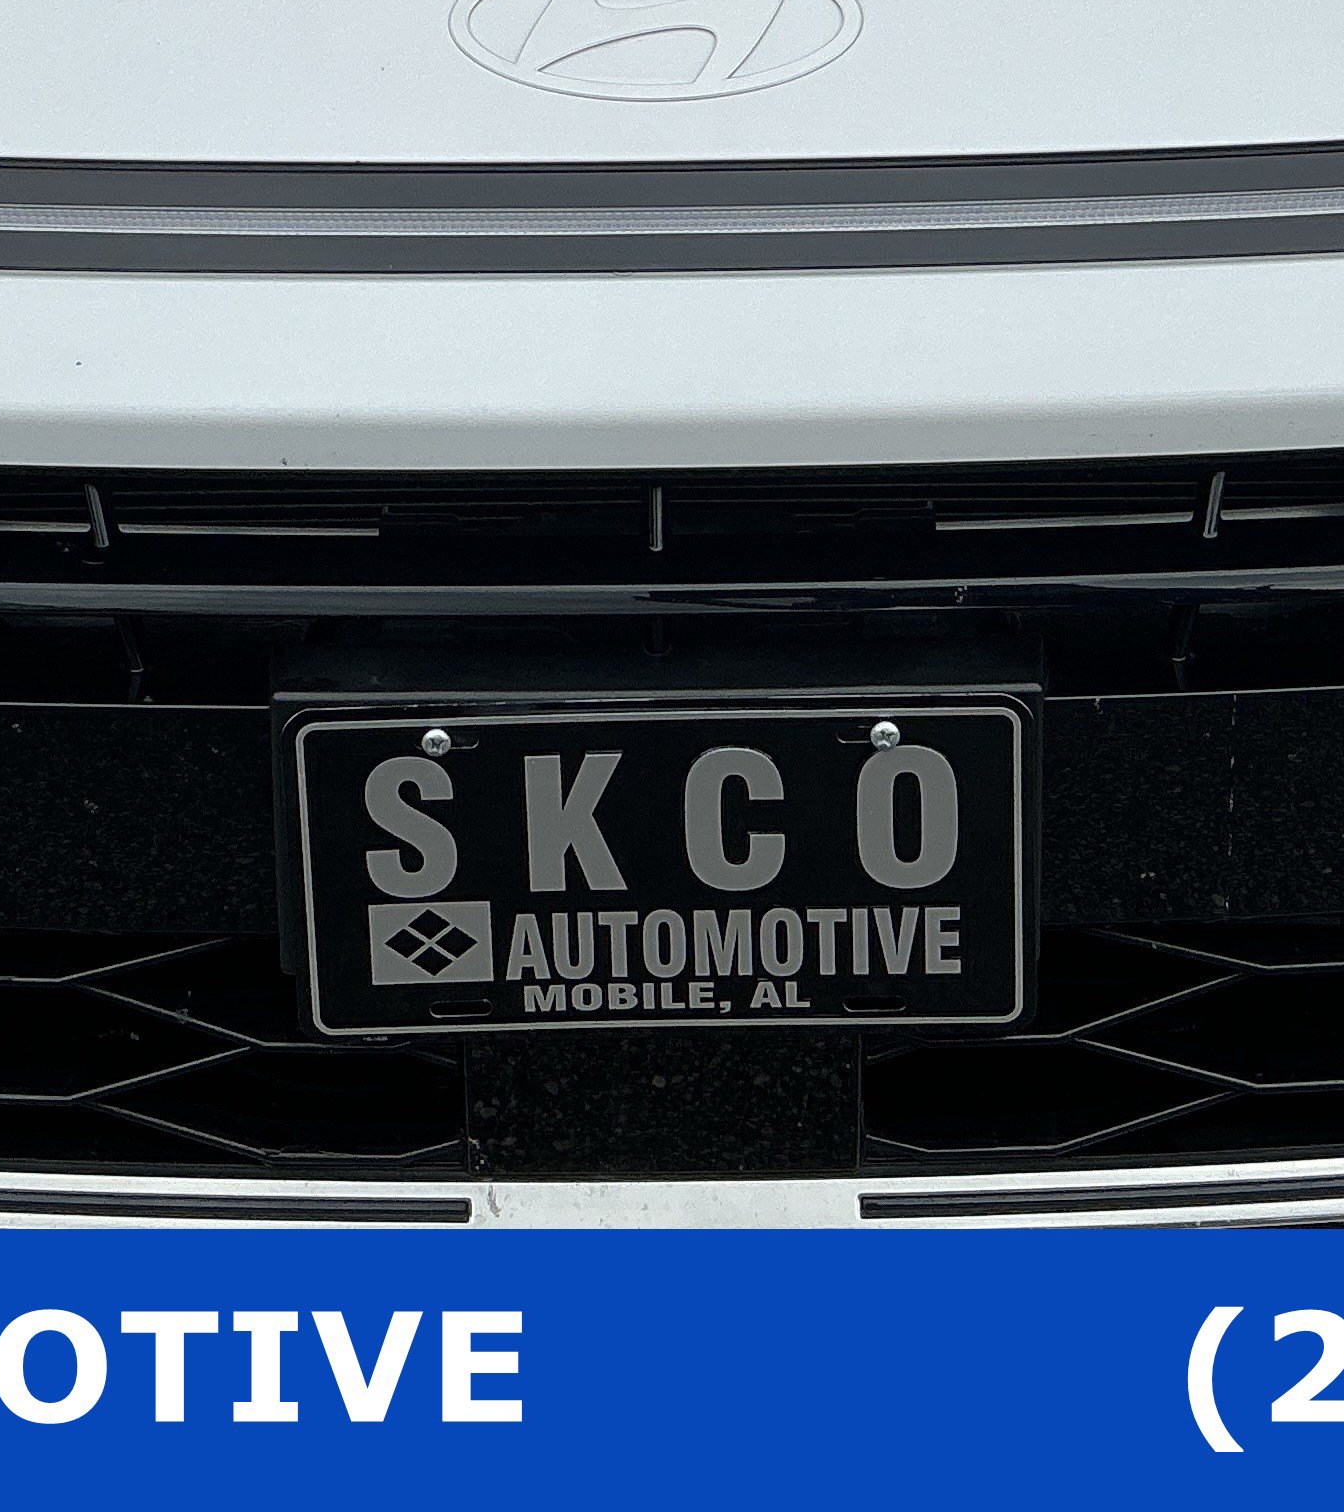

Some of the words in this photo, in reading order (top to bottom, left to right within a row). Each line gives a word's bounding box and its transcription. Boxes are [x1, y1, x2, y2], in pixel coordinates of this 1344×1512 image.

[505, 905, 963, 981] AUTOMOTIVE
[523, 981, 733, 1015] MOBILE,
[749, 979, 811, 1010] AL
